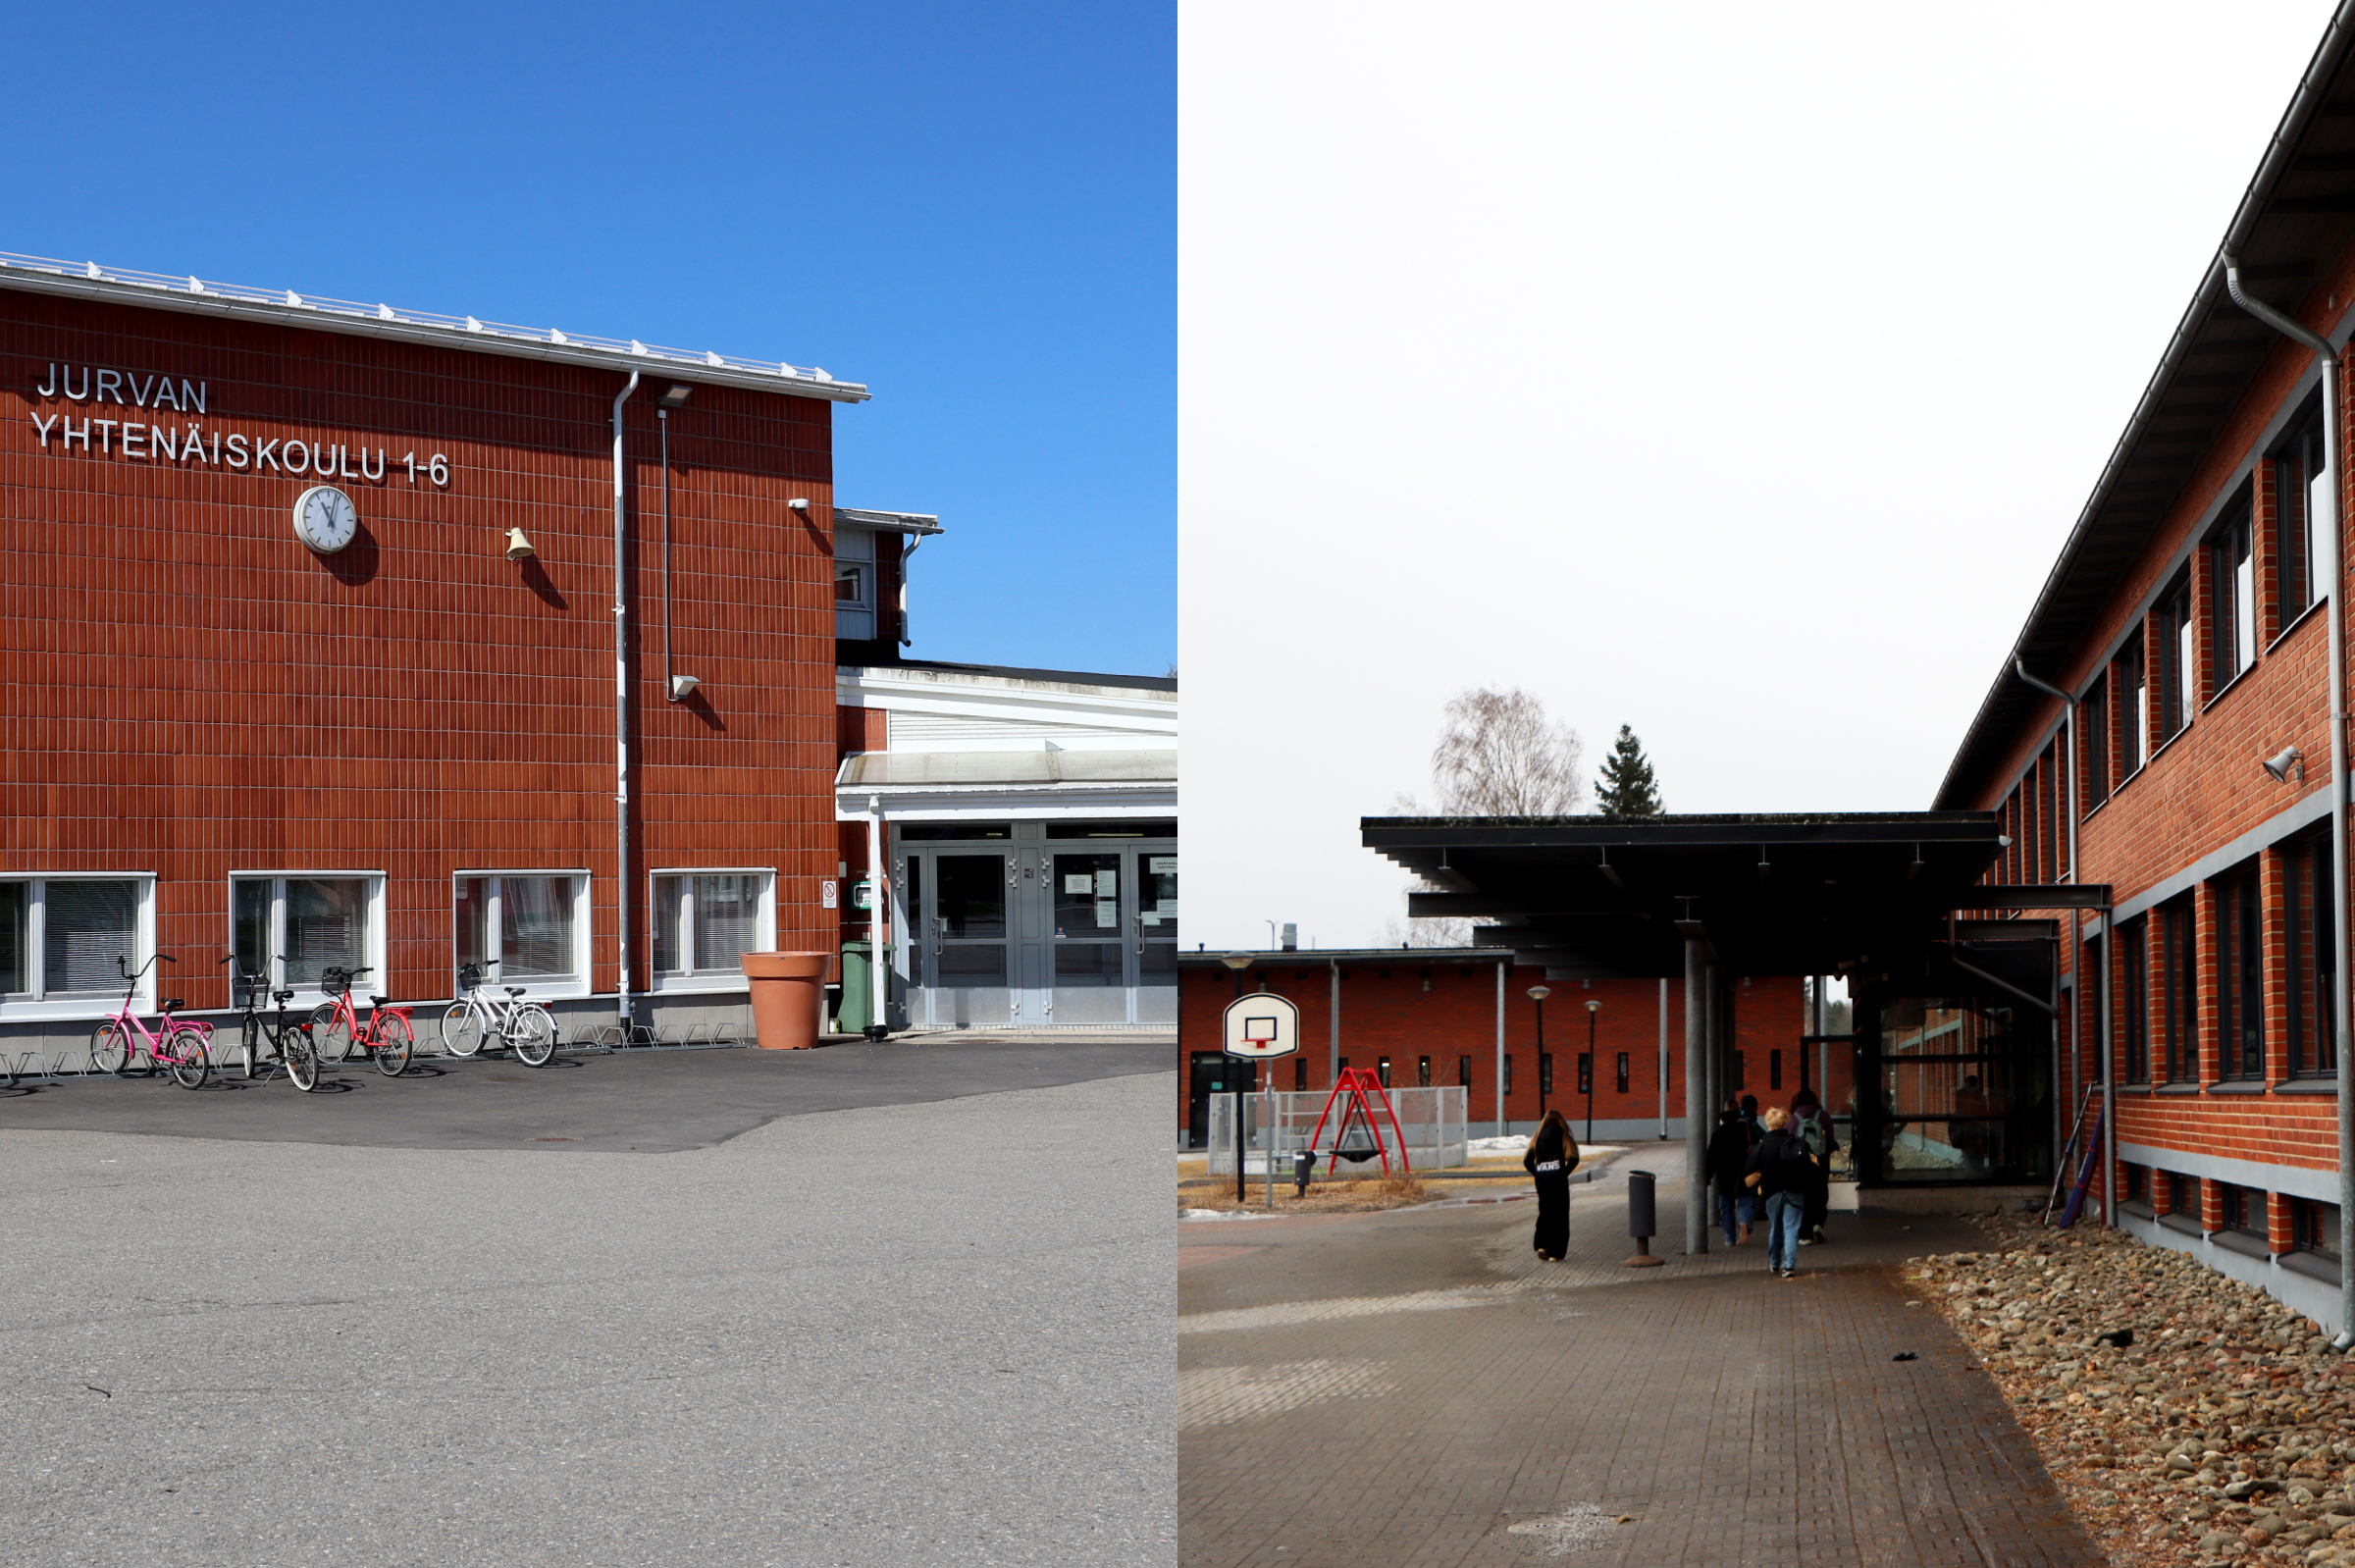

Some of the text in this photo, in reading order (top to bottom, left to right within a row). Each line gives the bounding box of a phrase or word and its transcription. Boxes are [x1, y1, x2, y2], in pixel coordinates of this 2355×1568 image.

[37, 362, 207, 414] JURVAN
[30, 411, 448, 487] YHTENÄISKOULU 1-6
[1537, 1159, 1560, 1172] VANS
